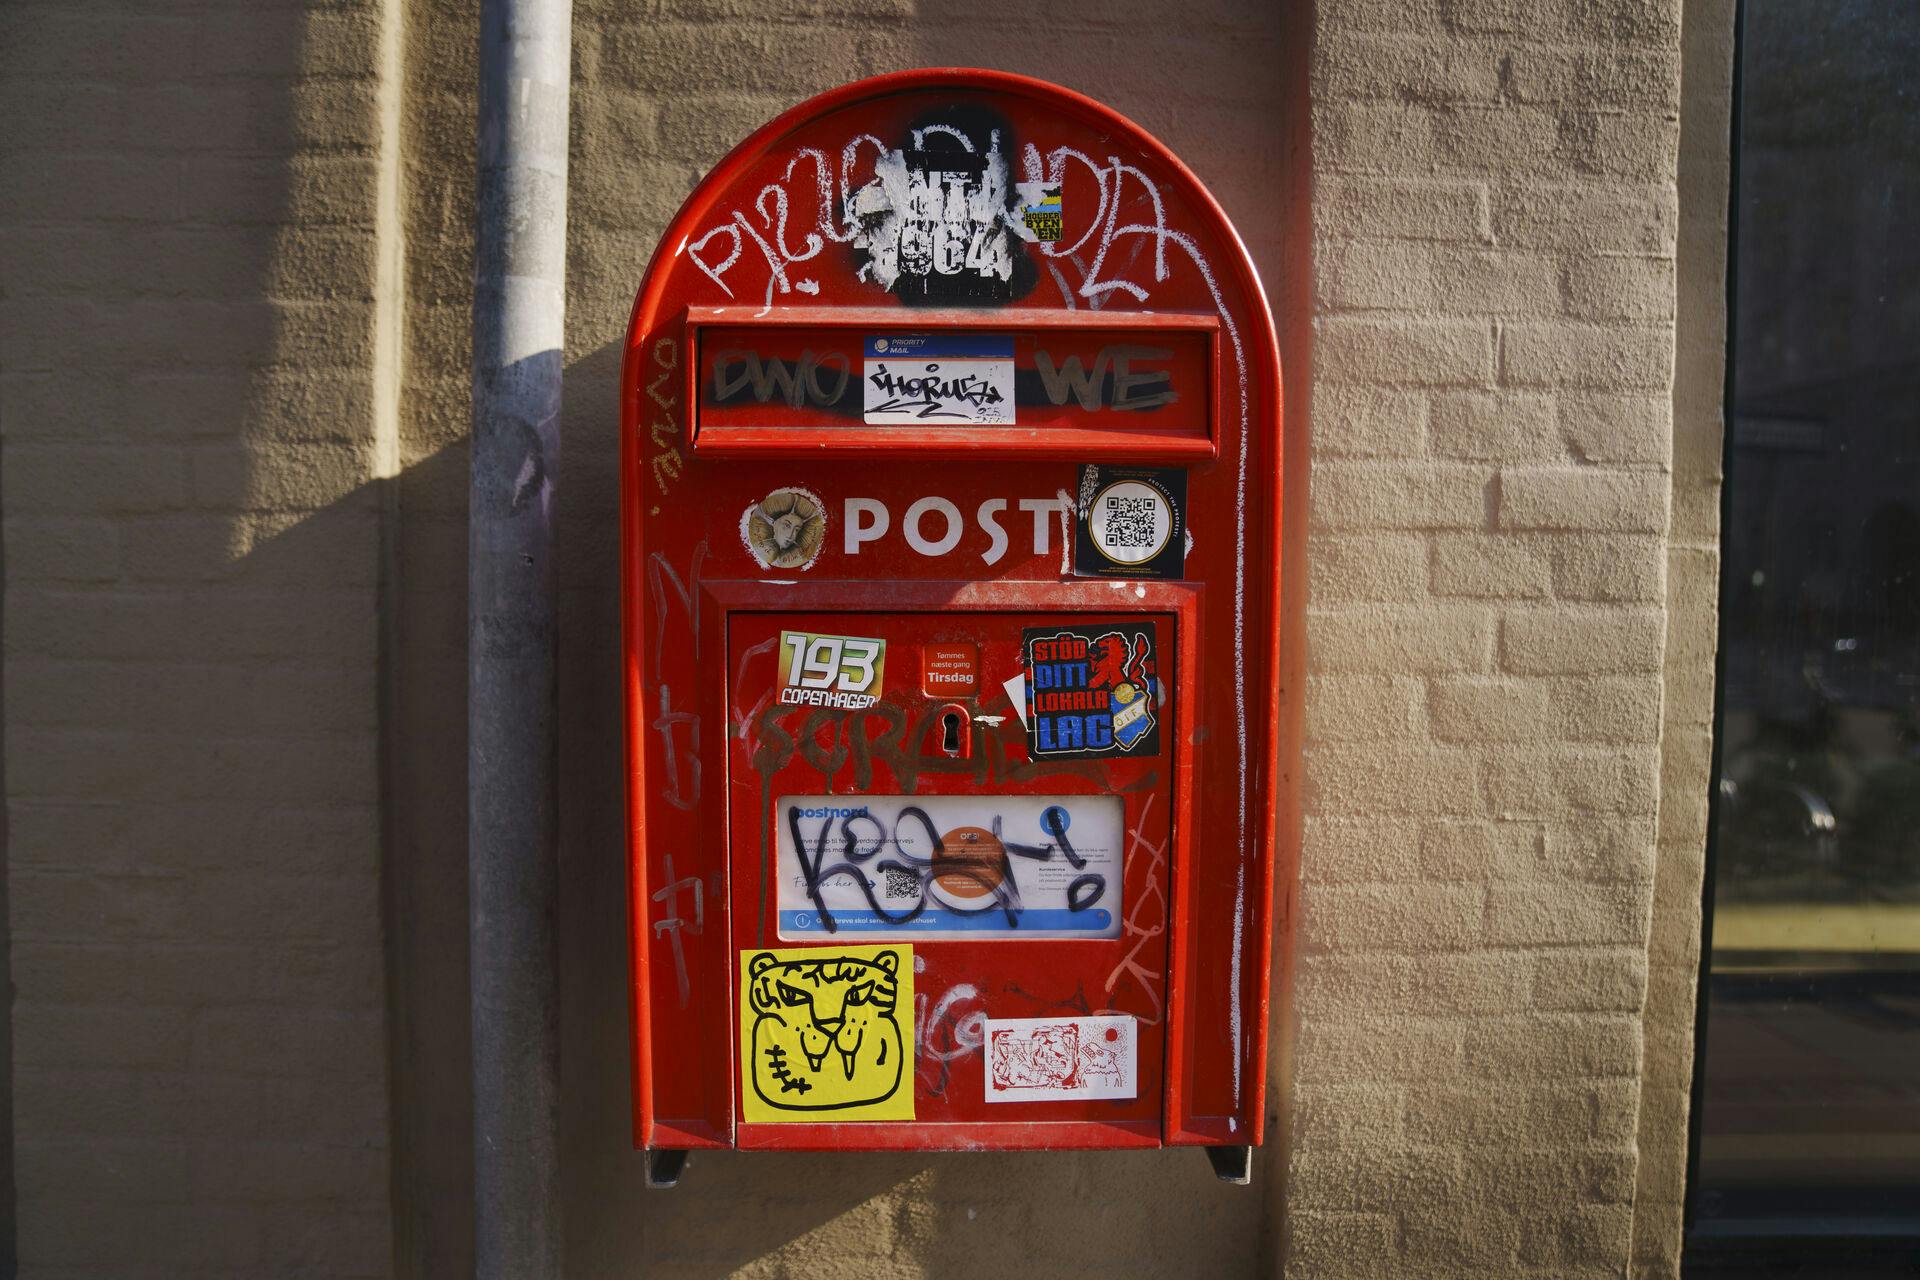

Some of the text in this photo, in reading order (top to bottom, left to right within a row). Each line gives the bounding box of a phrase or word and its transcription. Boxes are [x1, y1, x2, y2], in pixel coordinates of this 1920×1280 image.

[1026, 219, 1060, 228] BYEN
[1033, 228, 1060, 240] EN
[891, 338, 926, 346] PRIORITY
[844, 496, 1063, 566] POST
[1034, 637, 1086, 661] STÖD
[786, 635, 880, 692] 193
[953, 662, 971, 670] gang
[928, 672, 975, 684] Tirsdag
[1036, 663, 1088, 688] DITT
[781, 688, 876, 709] COPENHAGEN
[1036, 690, 1108, 712] LOKALA
[1039, 714, 1112, 750] LAG
